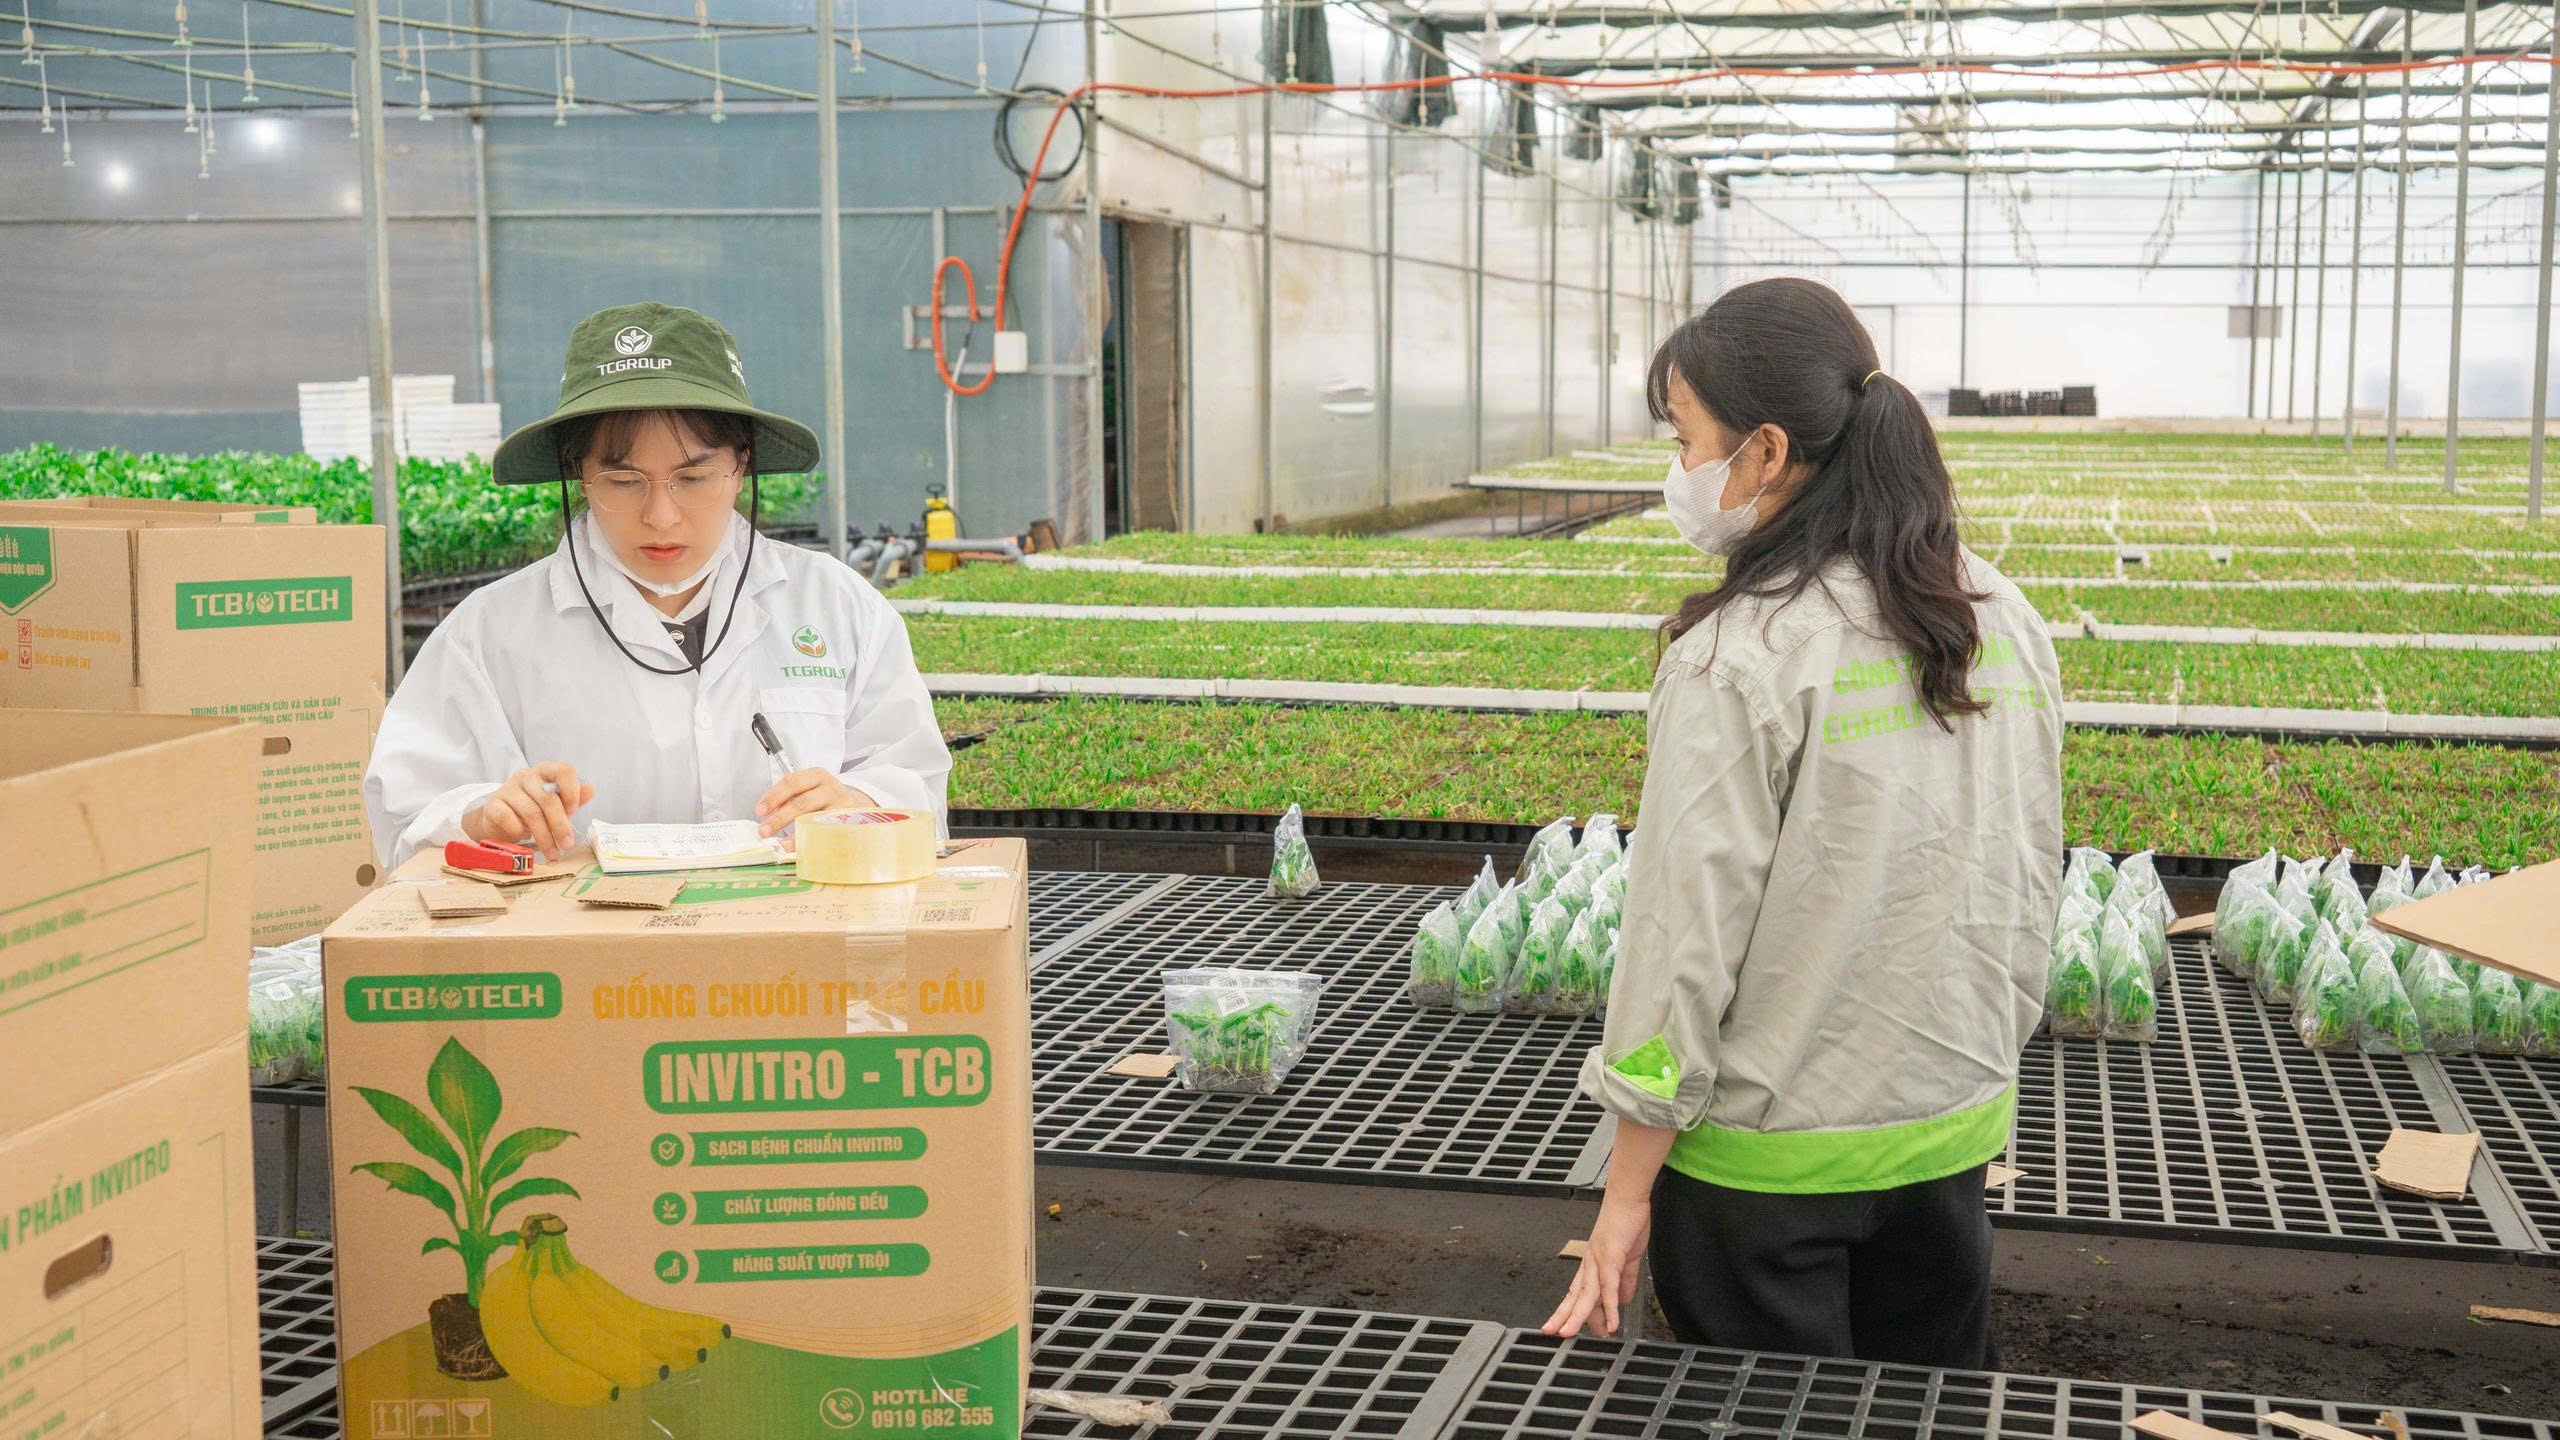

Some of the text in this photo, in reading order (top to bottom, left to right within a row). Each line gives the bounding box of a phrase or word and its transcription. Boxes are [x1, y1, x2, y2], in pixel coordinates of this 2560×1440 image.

[597, 357, 672, 376] TCGROUP
[191, 588, 339, 617] TCBIOTECH
[191, 705, 218, 716] TRUNG
[221, 703, 237, 714] TÂM
[240, 700, 270, 713] NGHIÊN
[291, 698, 301, 710] VÀ
[277, 713, 293, 724] CNC
[262, 921, 304, 934] TCBIOTECH
[361, 984, 545, 1011] TCBIOTECH
[592, 971, 697, 1020] GIỐNG
[708, 969, 809, 1018] CHUỐI
[919, 967, 985, 1016] CẦU
[659, 1046, 985, 1104] INVITRO - TCB
[709, 1132, 903, 1159] SẠCH BỆNH CHUẨN INVITRO
[90, 1139, 171, 1208] INVITRO
[725, 1193, 762, 1215] CHẤT
[765, 1195, 813, 1216] LƯỢNG
[732, 1250, 890, 1273] NĂNG SUẤT VƯỢT TRỘI
[872, 1387, 968, 1405] HOTLINE
[872, 1406, 994, 1428] 0919 682 555
